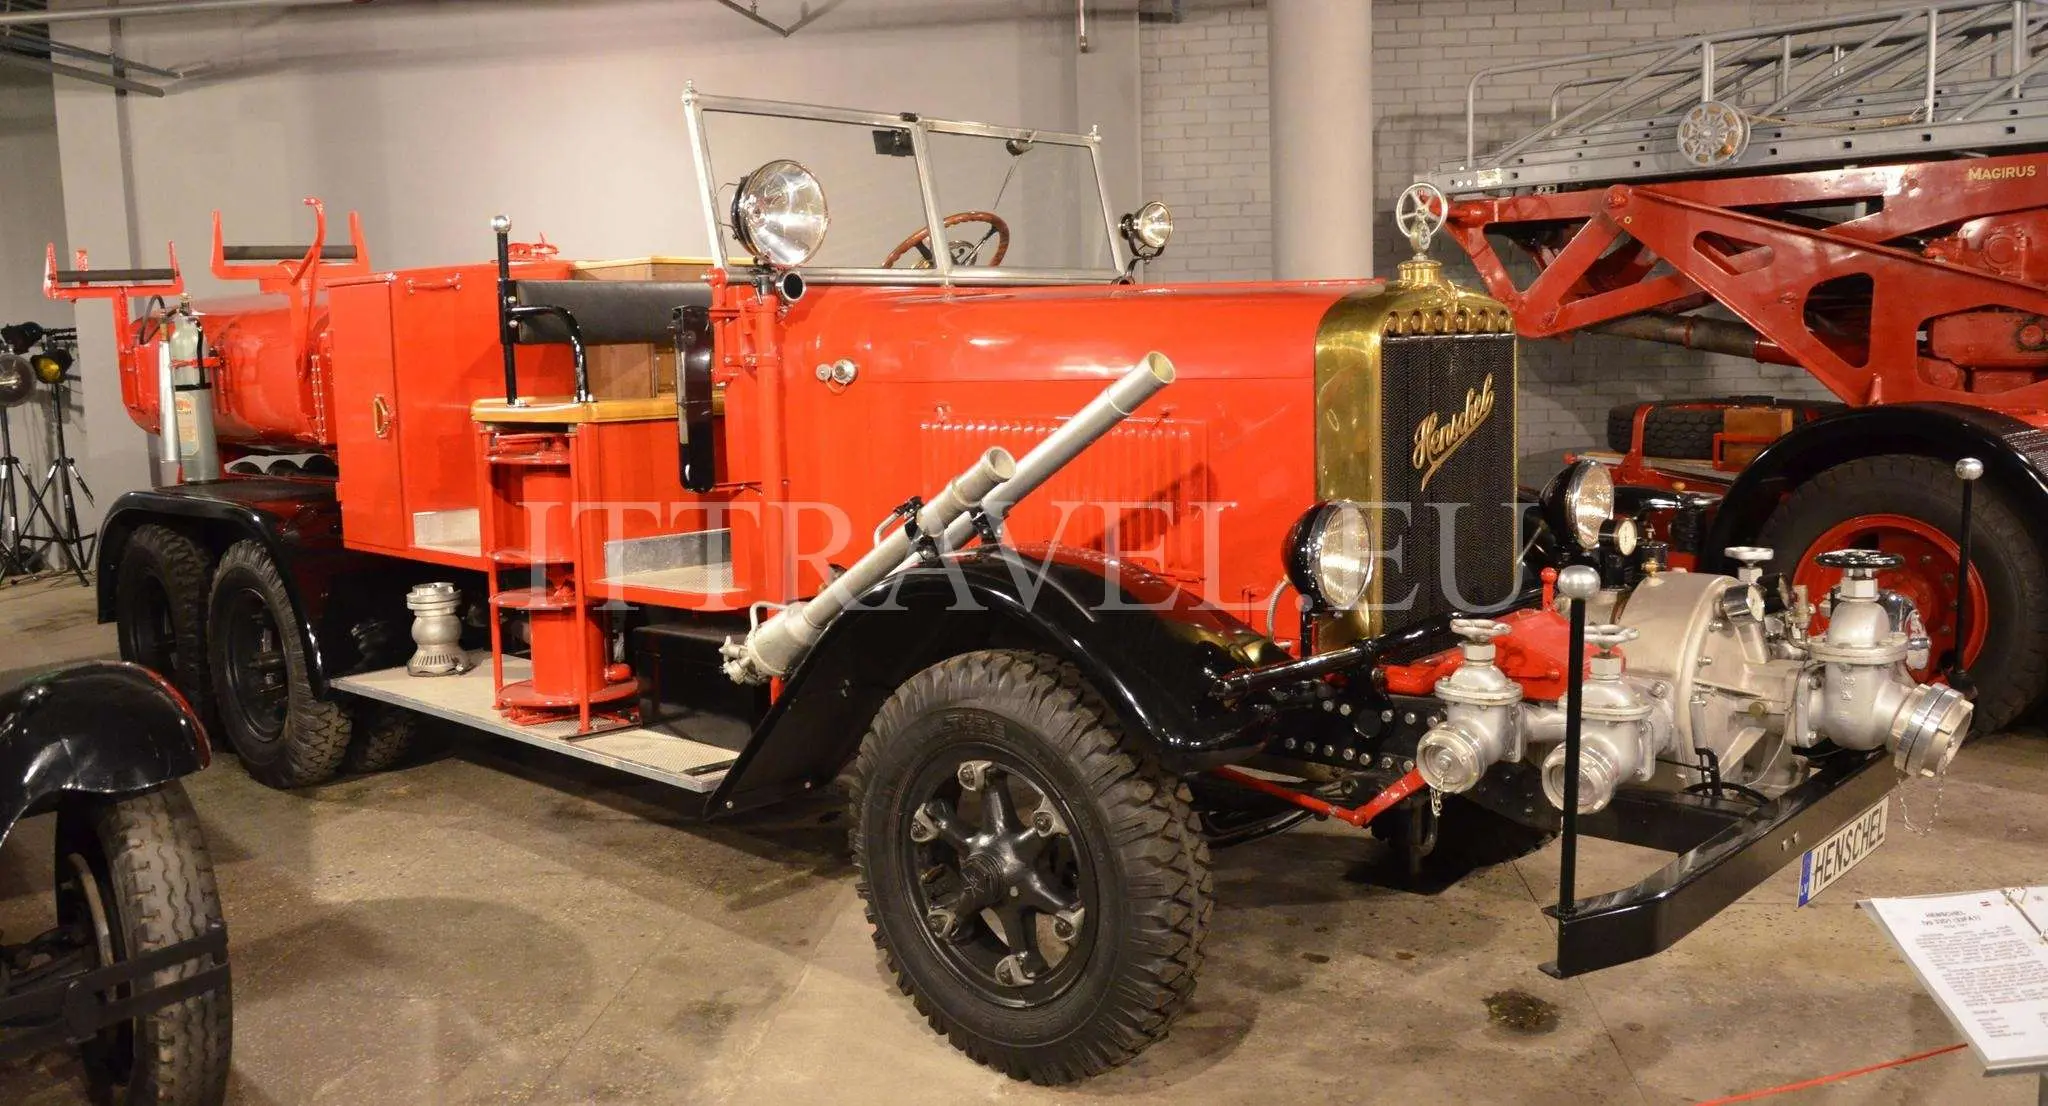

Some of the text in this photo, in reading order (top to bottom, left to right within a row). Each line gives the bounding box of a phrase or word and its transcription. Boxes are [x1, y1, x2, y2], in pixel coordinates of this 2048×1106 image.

[1968, 165, 2036, 180] MAGIRUS
[1413, 372, 1494, 492] Henschel
[1812, 806, 1885, 891] HENSCHEL
